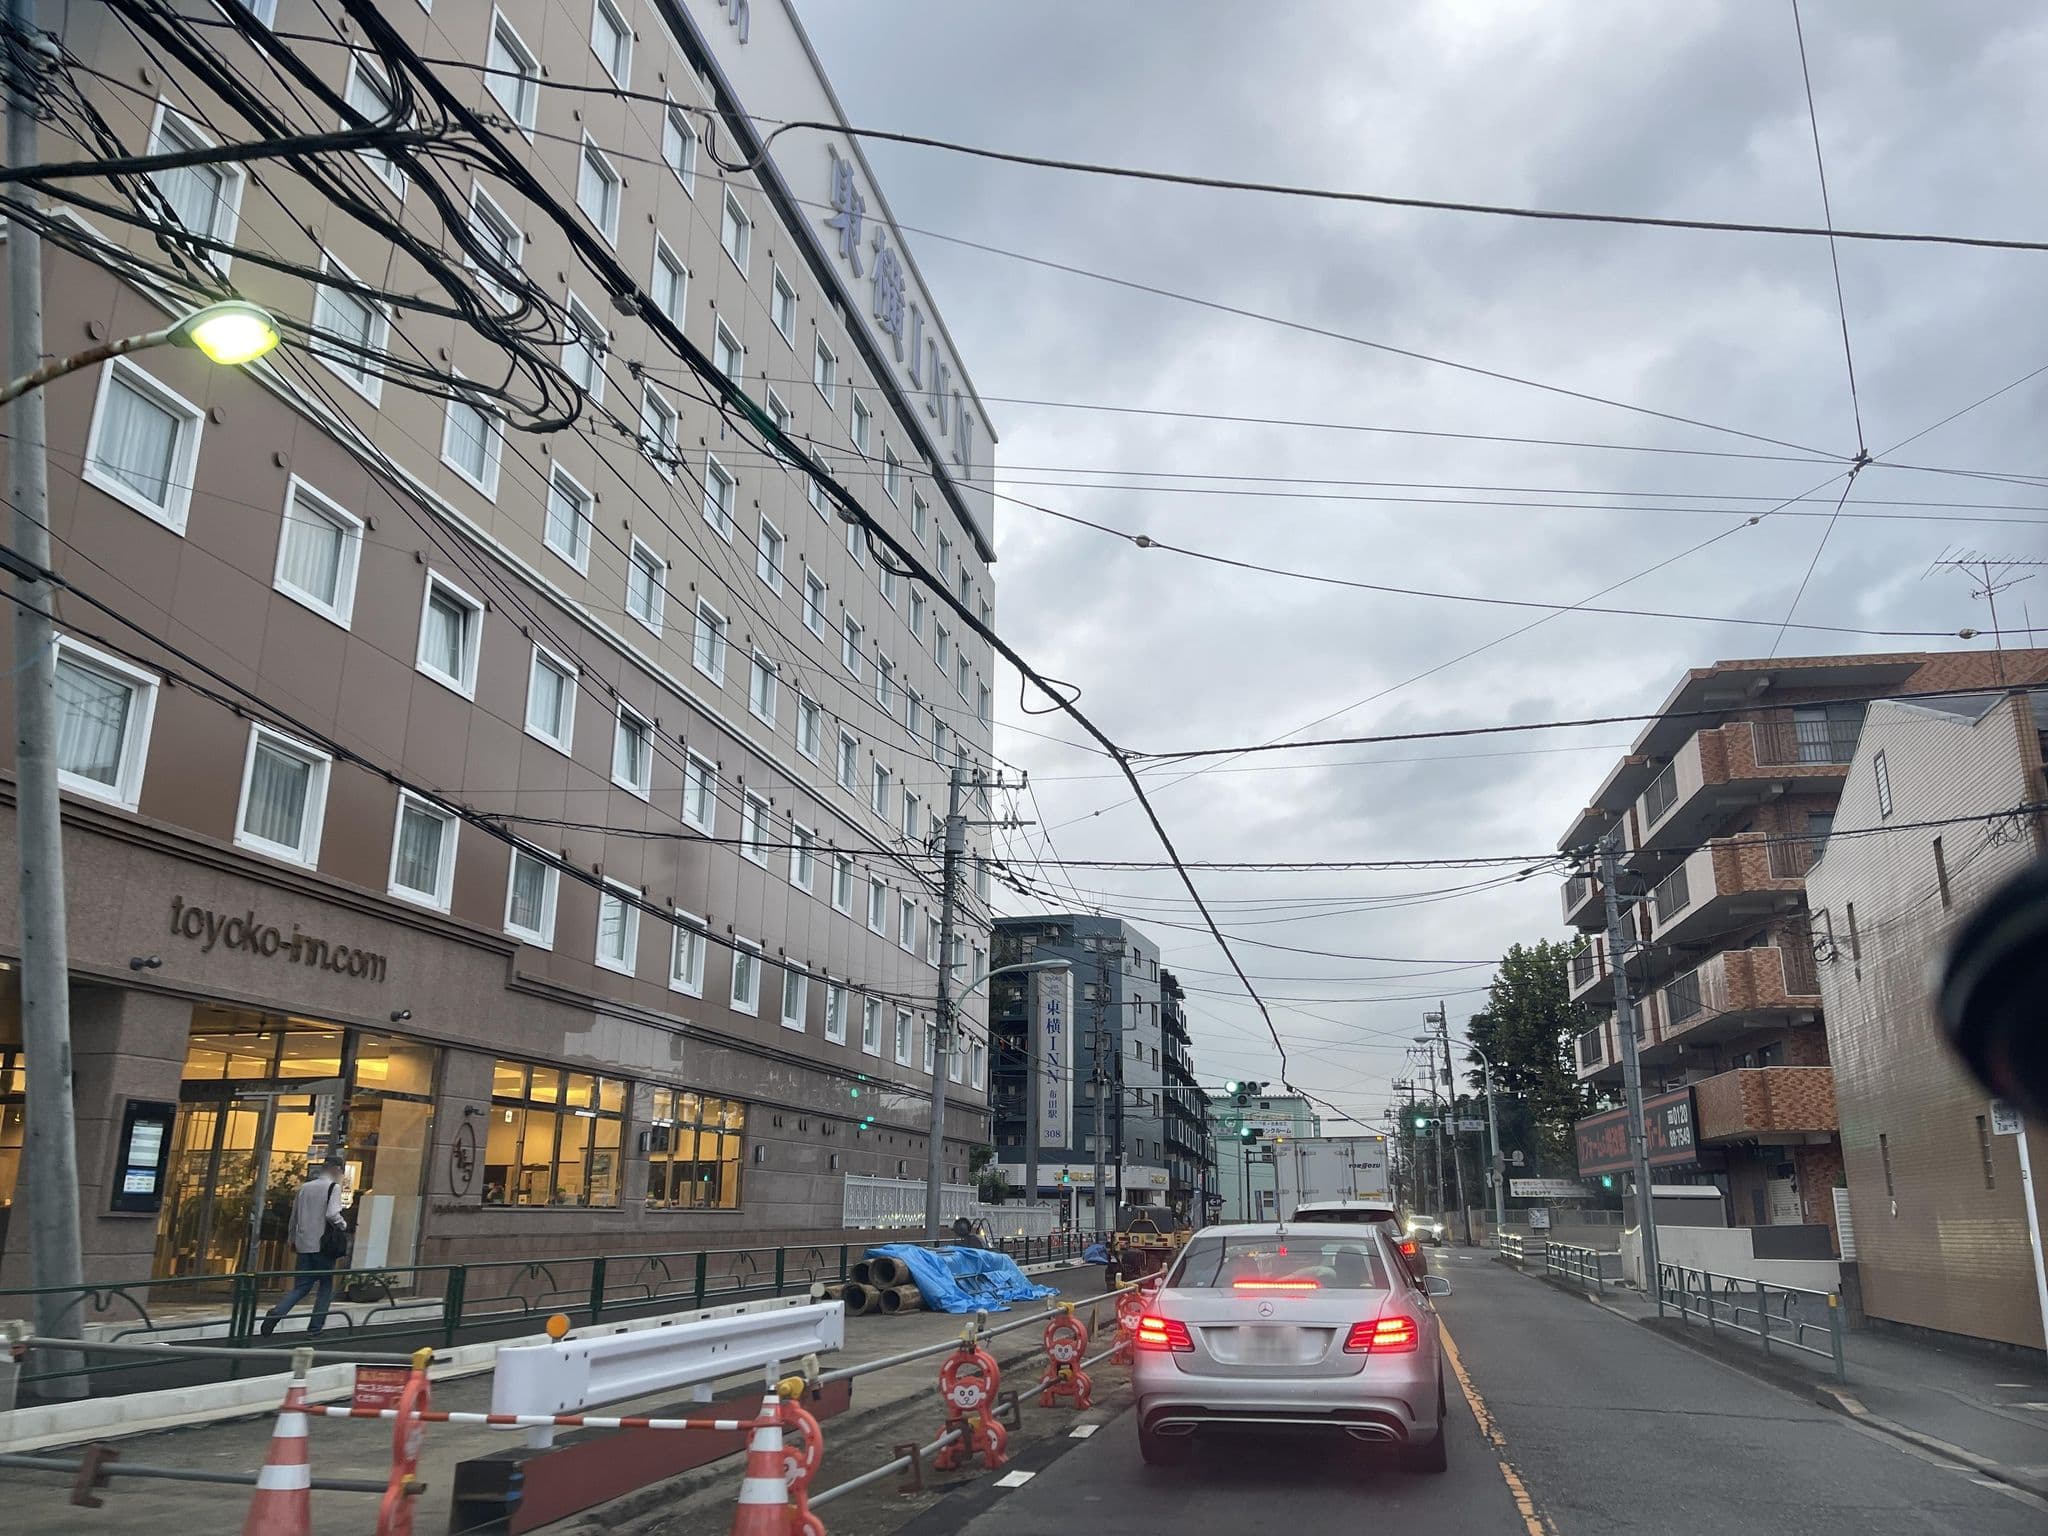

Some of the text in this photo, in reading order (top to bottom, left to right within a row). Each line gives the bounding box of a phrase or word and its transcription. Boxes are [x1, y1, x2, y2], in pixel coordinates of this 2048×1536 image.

[170, 895, 387, 983] toyoko-inn.com
[1046, 1000, 1061, 1084] 東横INN
[1044, 1130, 1061, 1138] 308
